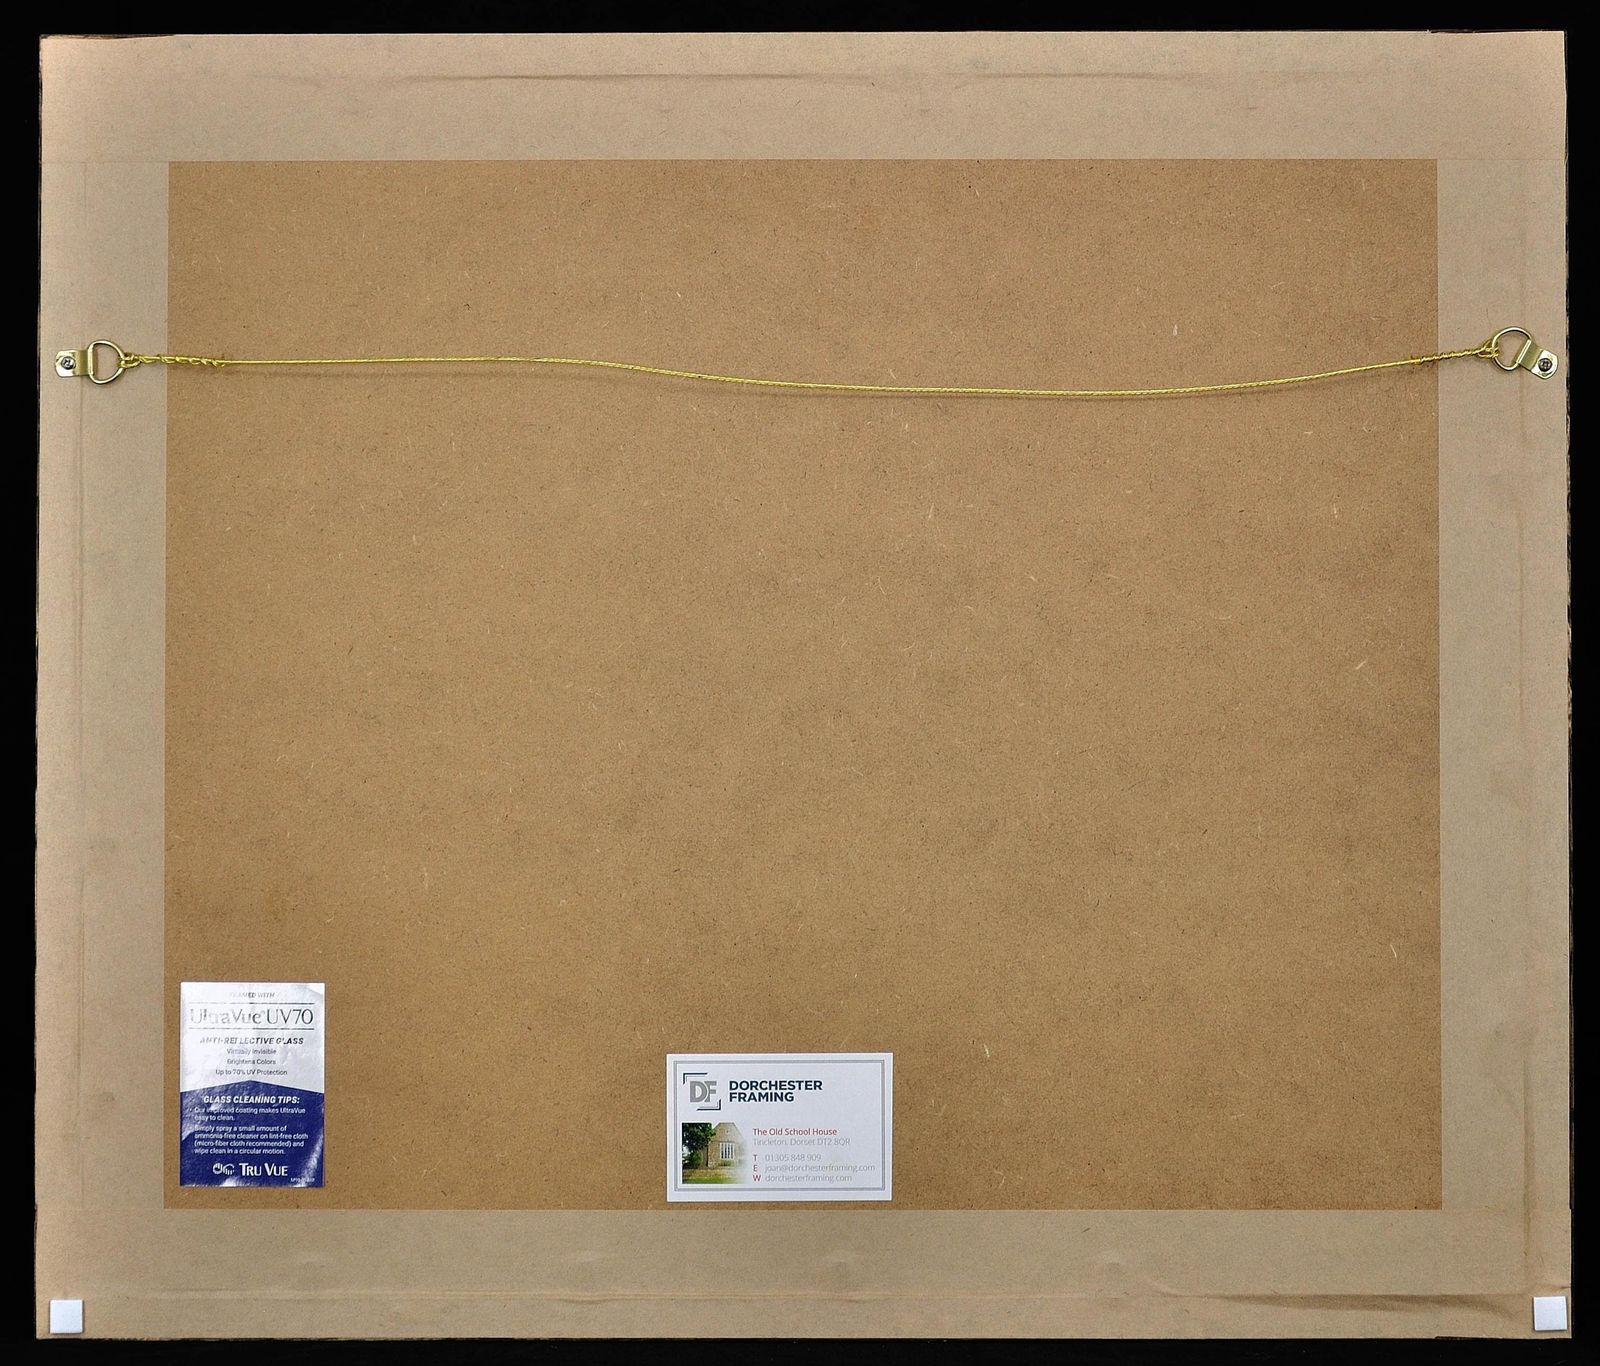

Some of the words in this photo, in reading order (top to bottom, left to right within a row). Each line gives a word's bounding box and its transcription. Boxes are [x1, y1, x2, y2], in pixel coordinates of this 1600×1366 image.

[267, 1008, 314, 1025] UV70
[276, 1037, 304, 1045] GLASS
[729, 1080, 823, 1091] DORCHESTER
[690, 1081, 717, 1103] DF
[729, 1092, 795, 1102] FRAMING
[203, 1096, 231, 1104] GLASS
[233, 1096, 276, 1104] CLEANING
[277, 1096, 300, 1104] TIPS:
[753, 1128, 768, 1136] The
[769, 1128, 783, 1136] Old
[784, 1128, 811, 1136] School
[812, 1128, 838, 1136] House
[790, 1138, 816, 1146] Dorset
[817, 1138, 833, 1146] DT2
[753, 1154, 758, 1162] T
[764, 1154, 790, 1162] 01305
[790, 1154, 806, 1162] 848
[806, 1154, 822, 1162] 909
[239, 1163, 262, 1176] TRU
[264, 1163, 288, 1176] VUE
[765, 1174, 853, 1184] dorchesterframing.com
